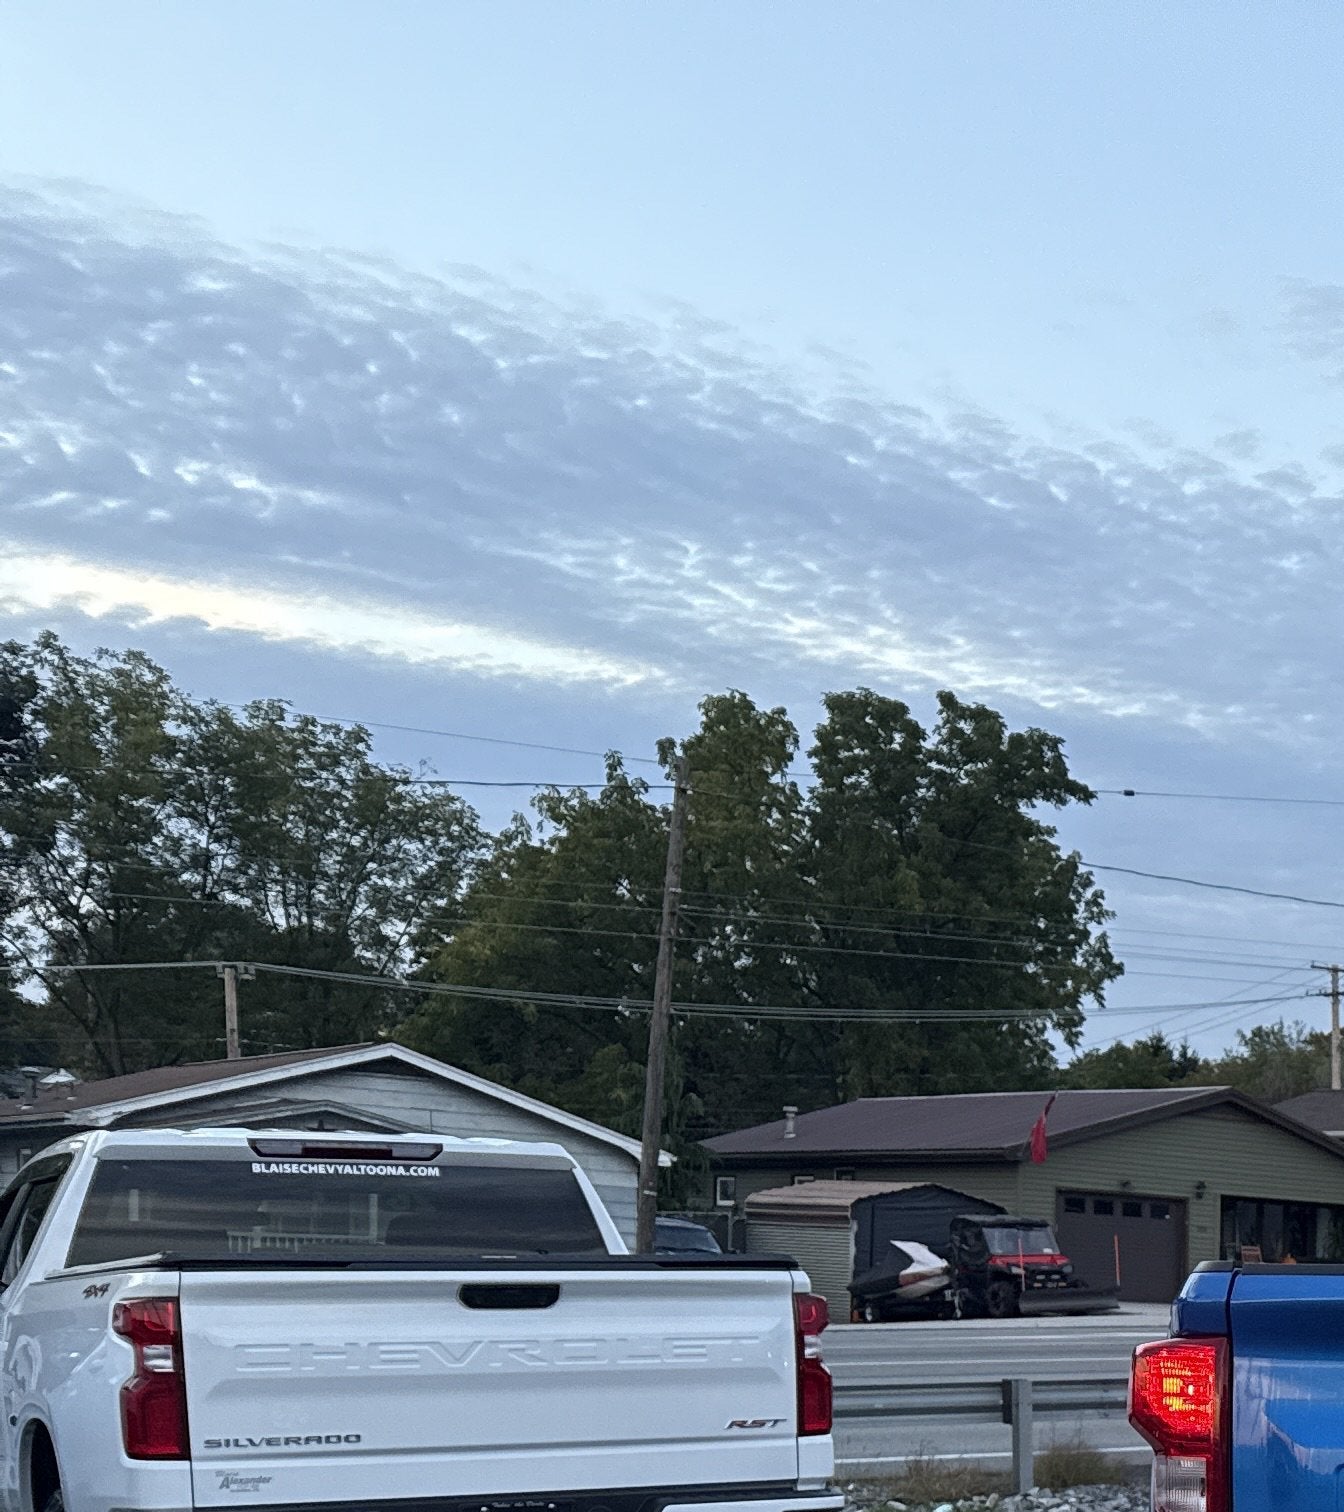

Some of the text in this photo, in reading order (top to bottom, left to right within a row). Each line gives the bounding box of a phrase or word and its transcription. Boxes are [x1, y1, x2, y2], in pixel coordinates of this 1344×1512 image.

[252, 1162, 440, 1177] BLAISECHEVYALTOONA.COM
[235, 1336, 760, 1372] CHEVROLET
[724, 1418, 788, 1430] RST
[204, 1434, 361, 1448] SILVERADO
[219, 1475, 273, 1490] Alexander
